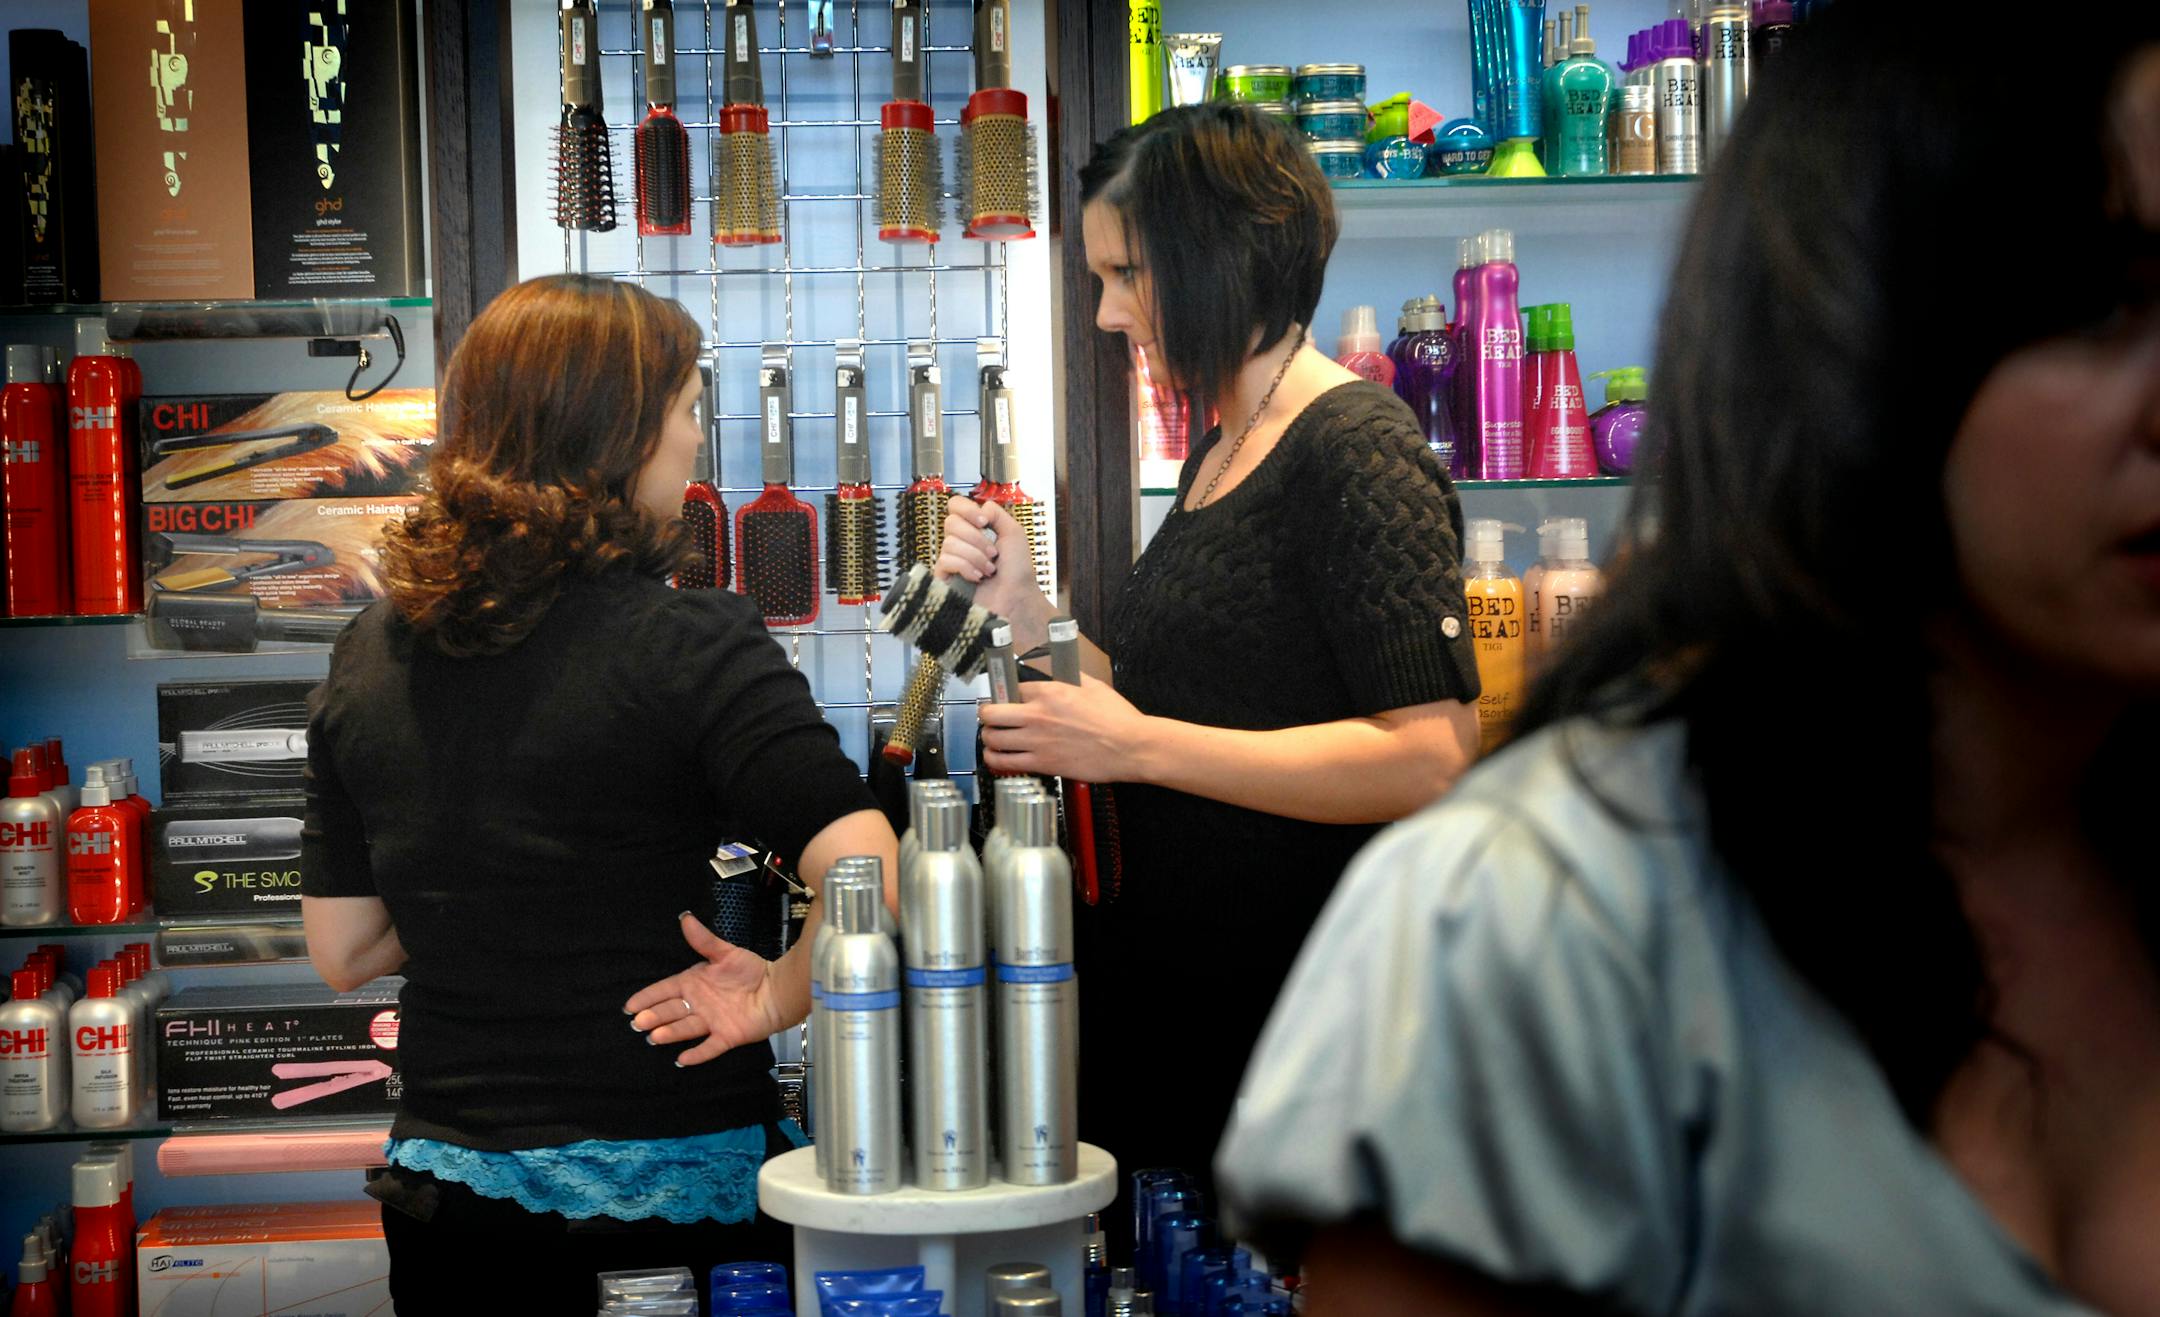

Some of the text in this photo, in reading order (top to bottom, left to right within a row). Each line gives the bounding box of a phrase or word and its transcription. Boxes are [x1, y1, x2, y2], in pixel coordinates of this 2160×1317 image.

[1568, 89, 1601, 101] BED
[1566, 102, 1603, 115] HEAD
[315, 198, 343, 216] ghd
[1486, 329, 1520, 344] BED
[1484, 345, 1522, 360] HEAD
[1554, 385, 1579, 396] BED
[317, 403, 363, 414] Ceramic
[1550, 397, 1583, 409] HEAD
[70, 406, 114, 430] CHI
[153, 404, 209, 430] CHI
[150, 505, 255, 532] BIG CHI
[316, 505, 365, 516] Ceramic
[1468, 596, 1515, 616] BED
[0, 821, 48, 847] CHI
[168, 834, 247, 847] PAUL MITCHELL
[68, 831, 112, 855] CHI
[222, 872, 257, 889] THE
[166, 1019, 220, 1038] FHI
[0, 1028, 46, 1054] CHI
[76, 1024, 129, 1051] CHI
[166, 1038, 224, 1047] TECHNIQUE
[74, 1260, 120, 1285] CHI
